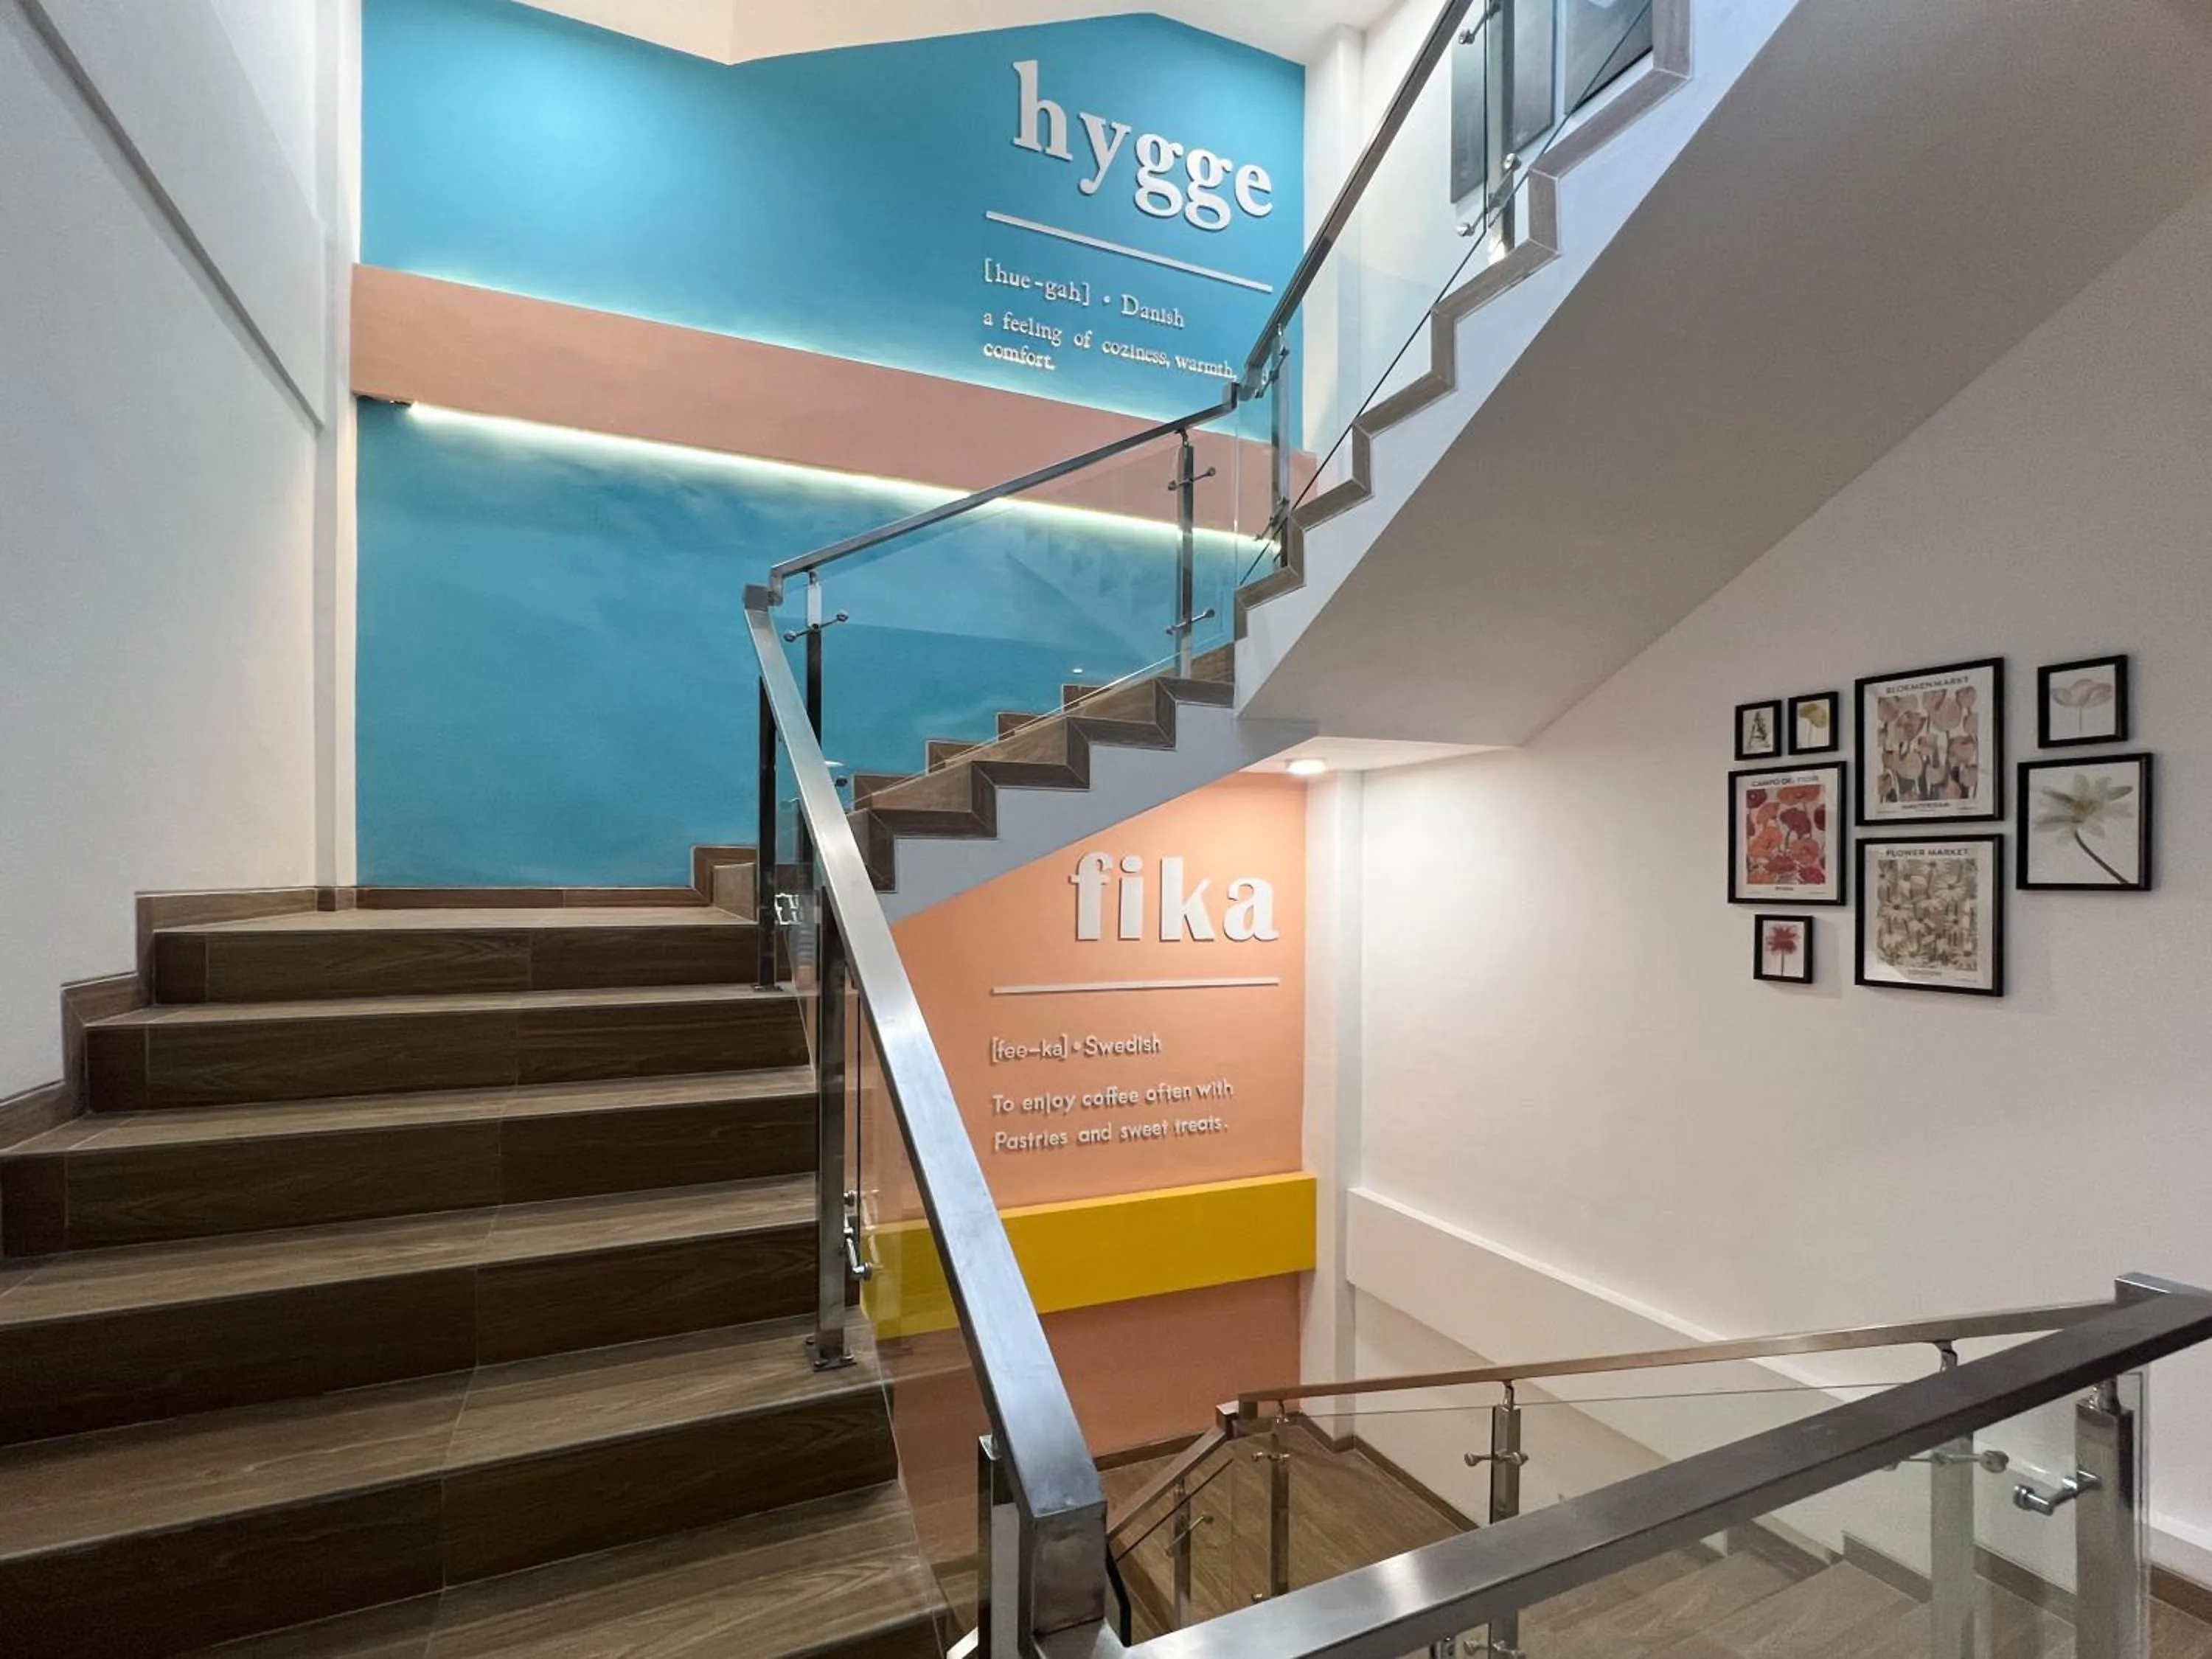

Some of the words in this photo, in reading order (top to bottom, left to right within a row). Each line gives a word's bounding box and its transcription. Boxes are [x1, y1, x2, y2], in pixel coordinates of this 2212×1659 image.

[1013, 60, 1273, 232] hygge
[984, 257, 1090, 307] [hue-gah]
[1121, 294, 1185, 328] Danish
[983, 312, 993, 327] a
[1003, 311, 1062, 347] feeling
[1074, 330, 1093, 348] of
[1102, 340, 1171, 369] coziness,
[1175, 354, 1238, 382] warmth,
[1885, 849, 1925, 857] FLOWER
[1069, 852, 1279, 942] fika
[1085, 1032, 1162, 1056] Swedish
[992, 1094, 1015, 1113] To
[1022, 1092, 1076, 1114] enjoy
[1082, 1085, 1138, 1107] coffee
[1145, 1082, 1192, 1103] often
[1197, 1078, 1234, 1099] with
[995, 1130, 1068, 1152] Pastries
[1078, 1122, 1112, 1143] and
[1120, 1120, 1169, 1141] sweet
[1174, 1115, 1228, 1135] treats.
